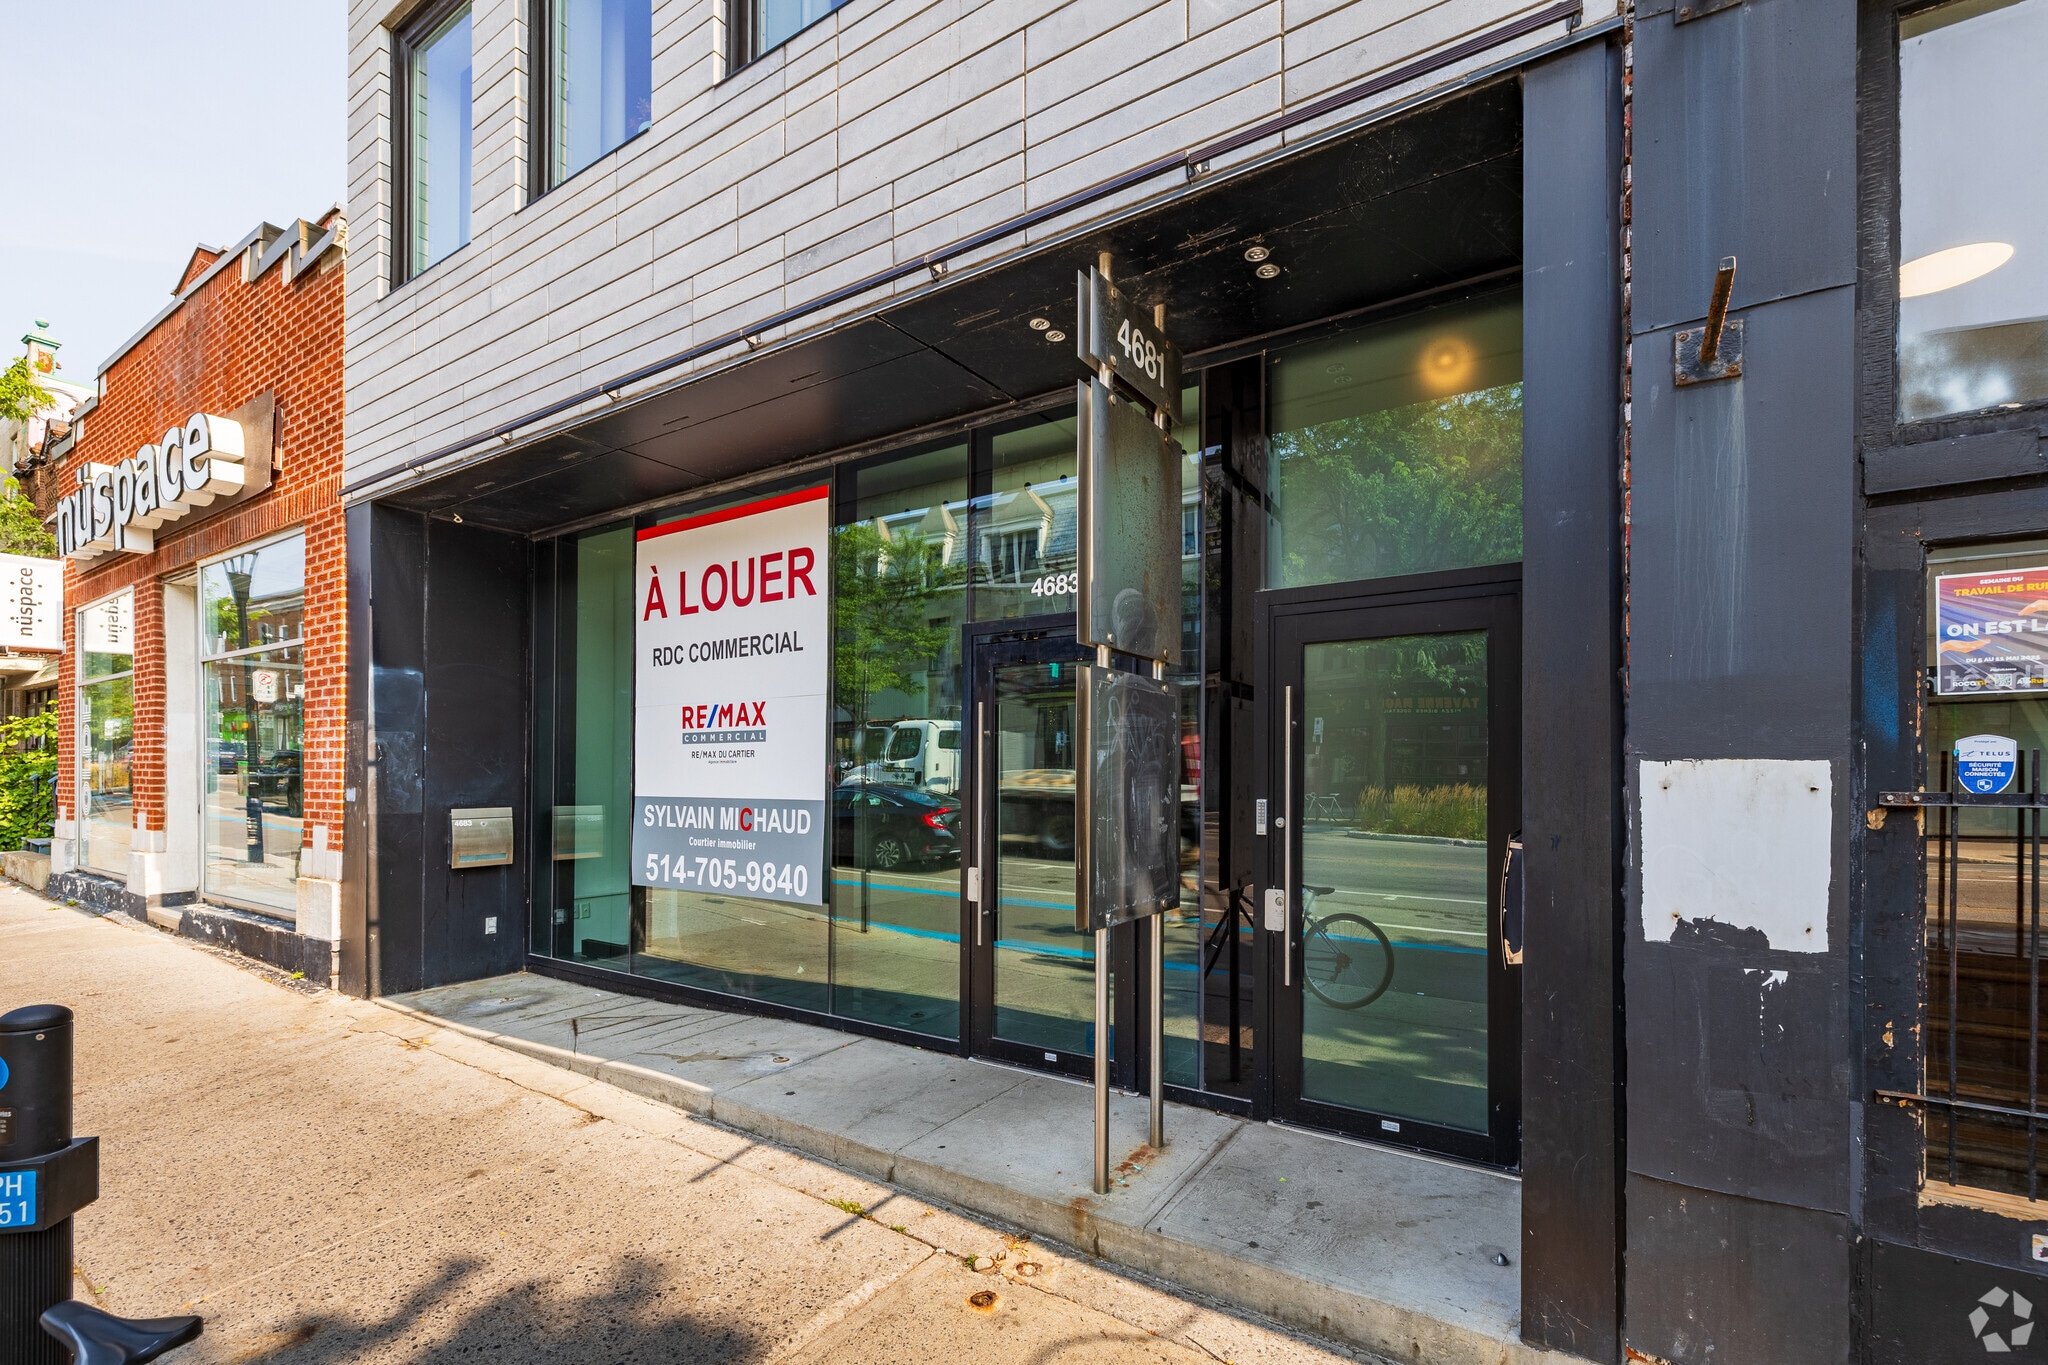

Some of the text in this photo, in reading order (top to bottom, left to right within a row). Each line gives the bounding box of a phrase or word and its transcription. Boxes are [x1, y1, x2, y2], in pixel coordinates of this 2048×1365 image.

[1118, 318, 1164, 388] 4681
[57, 412, 212, 557] nüspace
[643, 547, 817, 621] À LOUER
[1031, 572, 1078, 597] 4683
[1954, 586, 2005, 597] TRAVAIL
[2007, 584, 2024, 593] DE
[16, 567, 36, 637] nüspace
[1946, 622, 1979, 637] ON
[1985, 620, 2027, 635] EST
[653, 631, 804, 667] RDC COMMERCIAL
[682, 701, 767, 730] RE/MAX
[684, 732, 764, 743] COMMERCIAL
[691, 749, 755, 760] RE/MAX DU CARTIER
[644, 804, 811, 835] SYLVAIN MICHAUD
[689, 837, 756, 850] Courtier immobilier
[646, 853, 808, 897] 514-705-9840
